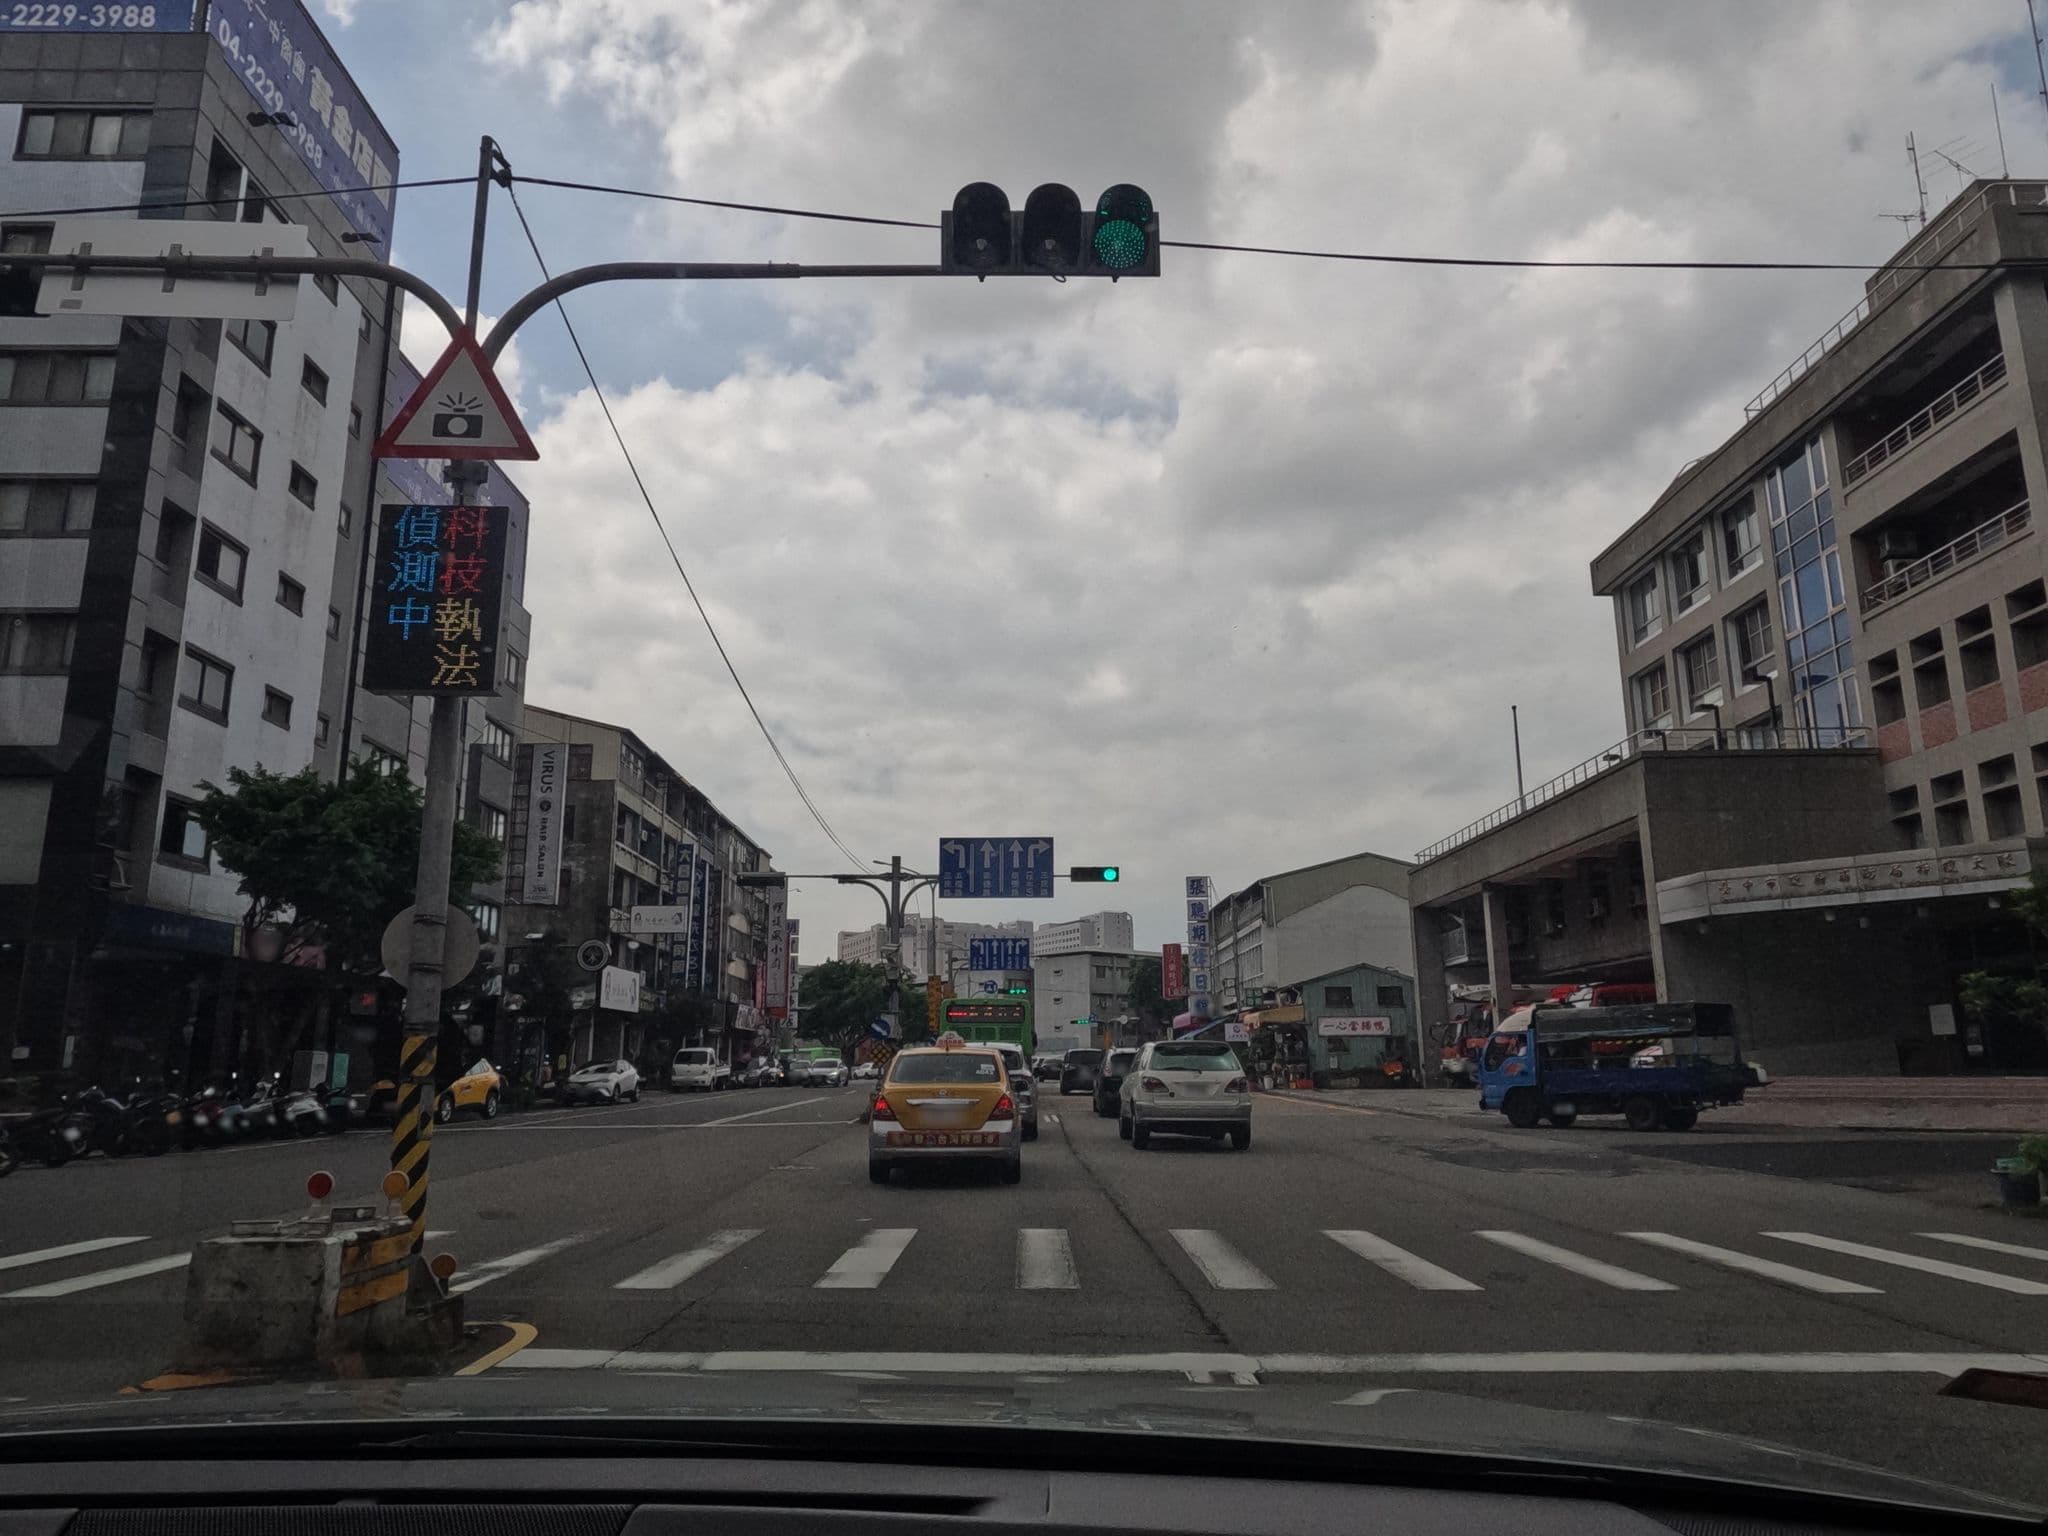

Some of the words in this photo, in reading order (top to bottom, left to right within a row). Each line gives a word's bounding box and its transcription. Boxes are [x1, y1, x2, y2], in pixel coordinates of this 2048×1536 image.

[218, 18, 323, 169] 04-22293988
[309, 65, 392, 212] 黃金店面
[386, 505, 441, 641] 偵測中
[430, 506, 490, 687] 科技執法
[538, 816, 549, 842] HAIR
[539, 749, 556, 795] VIRUS
[536, 844, 547, 878] SALON
